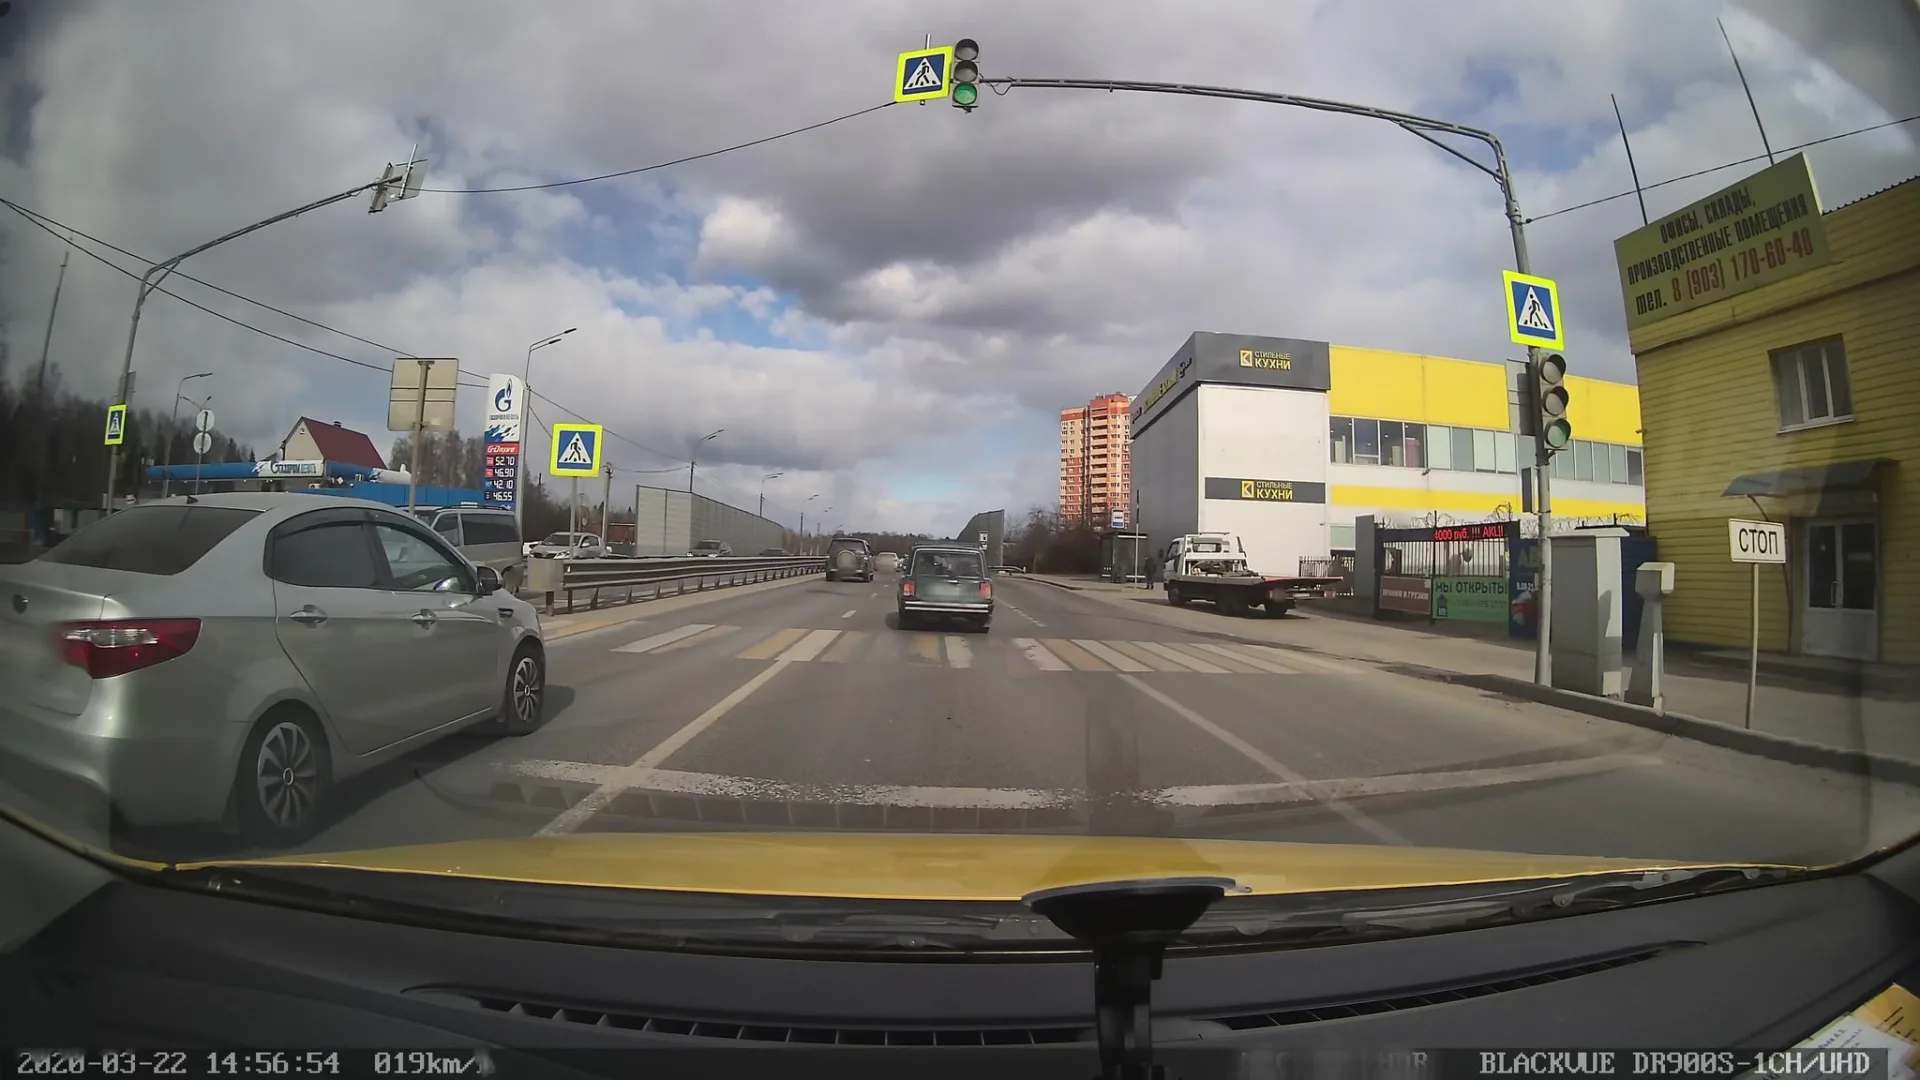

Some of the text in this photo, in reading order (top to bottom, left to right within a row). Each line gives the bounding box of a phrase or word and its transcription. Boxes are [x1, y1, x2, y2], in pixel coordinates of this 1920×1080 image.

[1659, 186, 1756, 244] ОФИСЫ, СКЛАДЫ,
[1627, 193, 1809, 285] ПРОИЗВОДСТВЕННЫЕ ПОМЕЩЕНИЯ
[1635, 288, 1668, 316] тел.
[1671, 276, 1682, 302] 8
[1686, 258, 1726, 300] (903)
[1254, 351, 1291, 360] СТИЛЬНЫЕ
[1255, 358, 1291, 370] КУХНИ
[1256, 481, 1293, 489] СТИЛЬНЫЕ
[1256, 489, 1293, 500] КУХНИ
[1738, 527, 1778, 555] СТОП
[1435, 581, 1452, 593] МЫ
[1455, 581, 1508, 595] ОТКРЫТЫ
